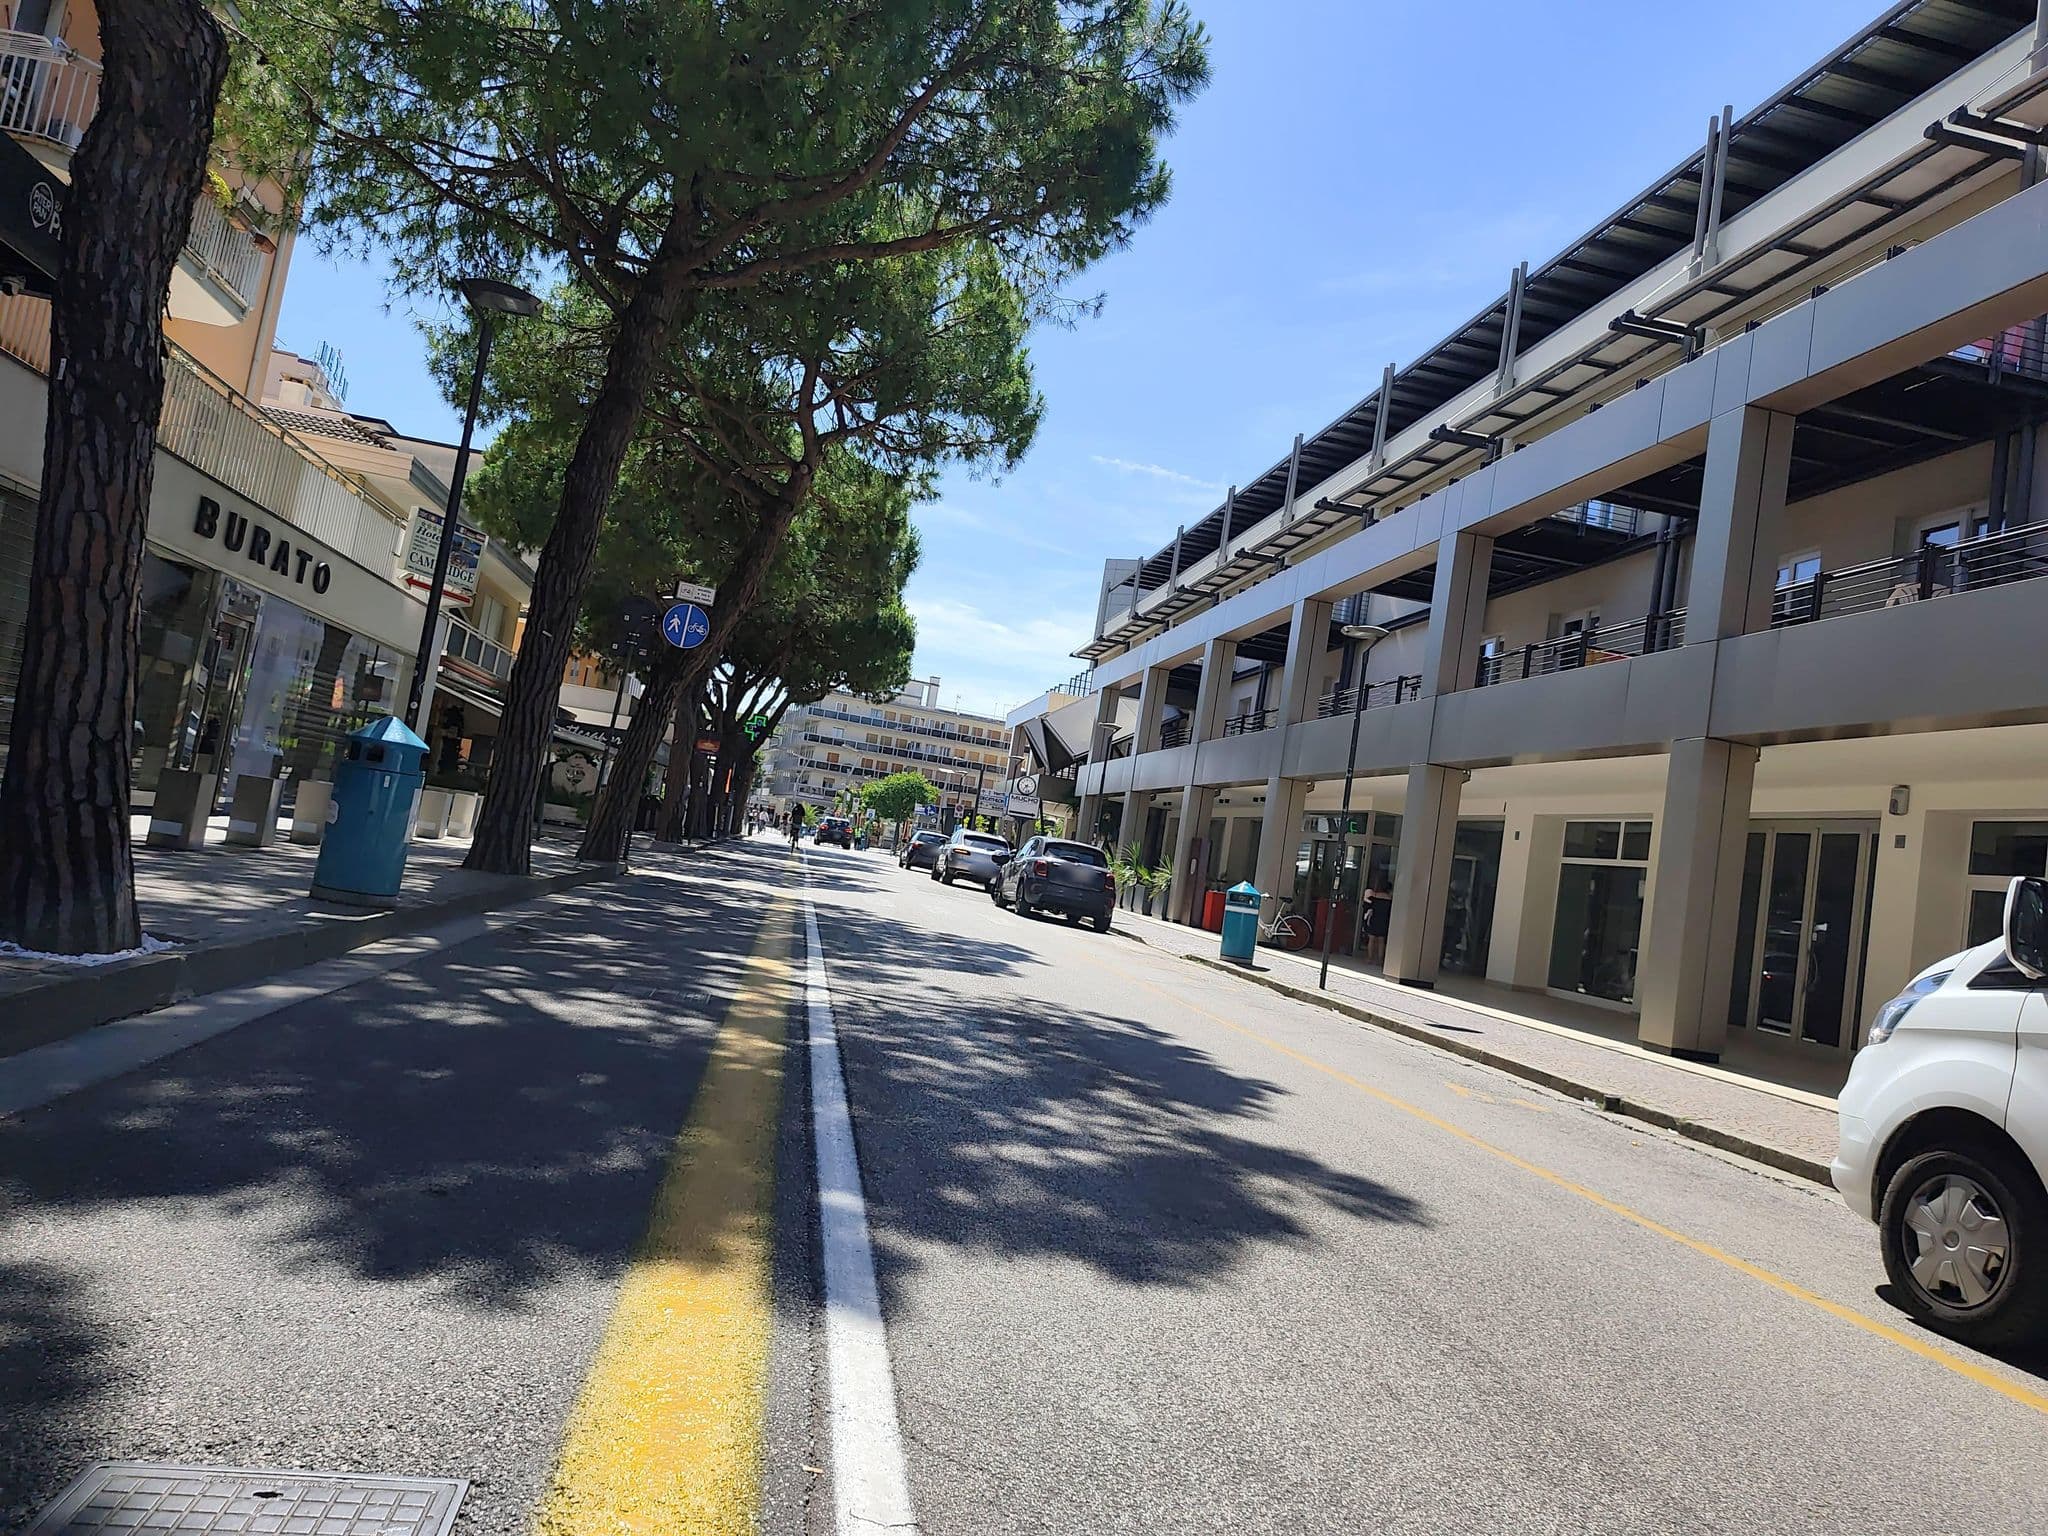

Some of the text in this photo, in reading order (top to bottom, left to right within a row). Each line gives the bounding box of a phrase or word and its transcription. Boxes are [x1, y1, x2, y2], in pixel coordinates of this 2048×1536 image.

[194, 495, 331, 595] BURATO
[416, 525, 443, 542] Hote
[409, 551, 475, 584] CAMIDGE
